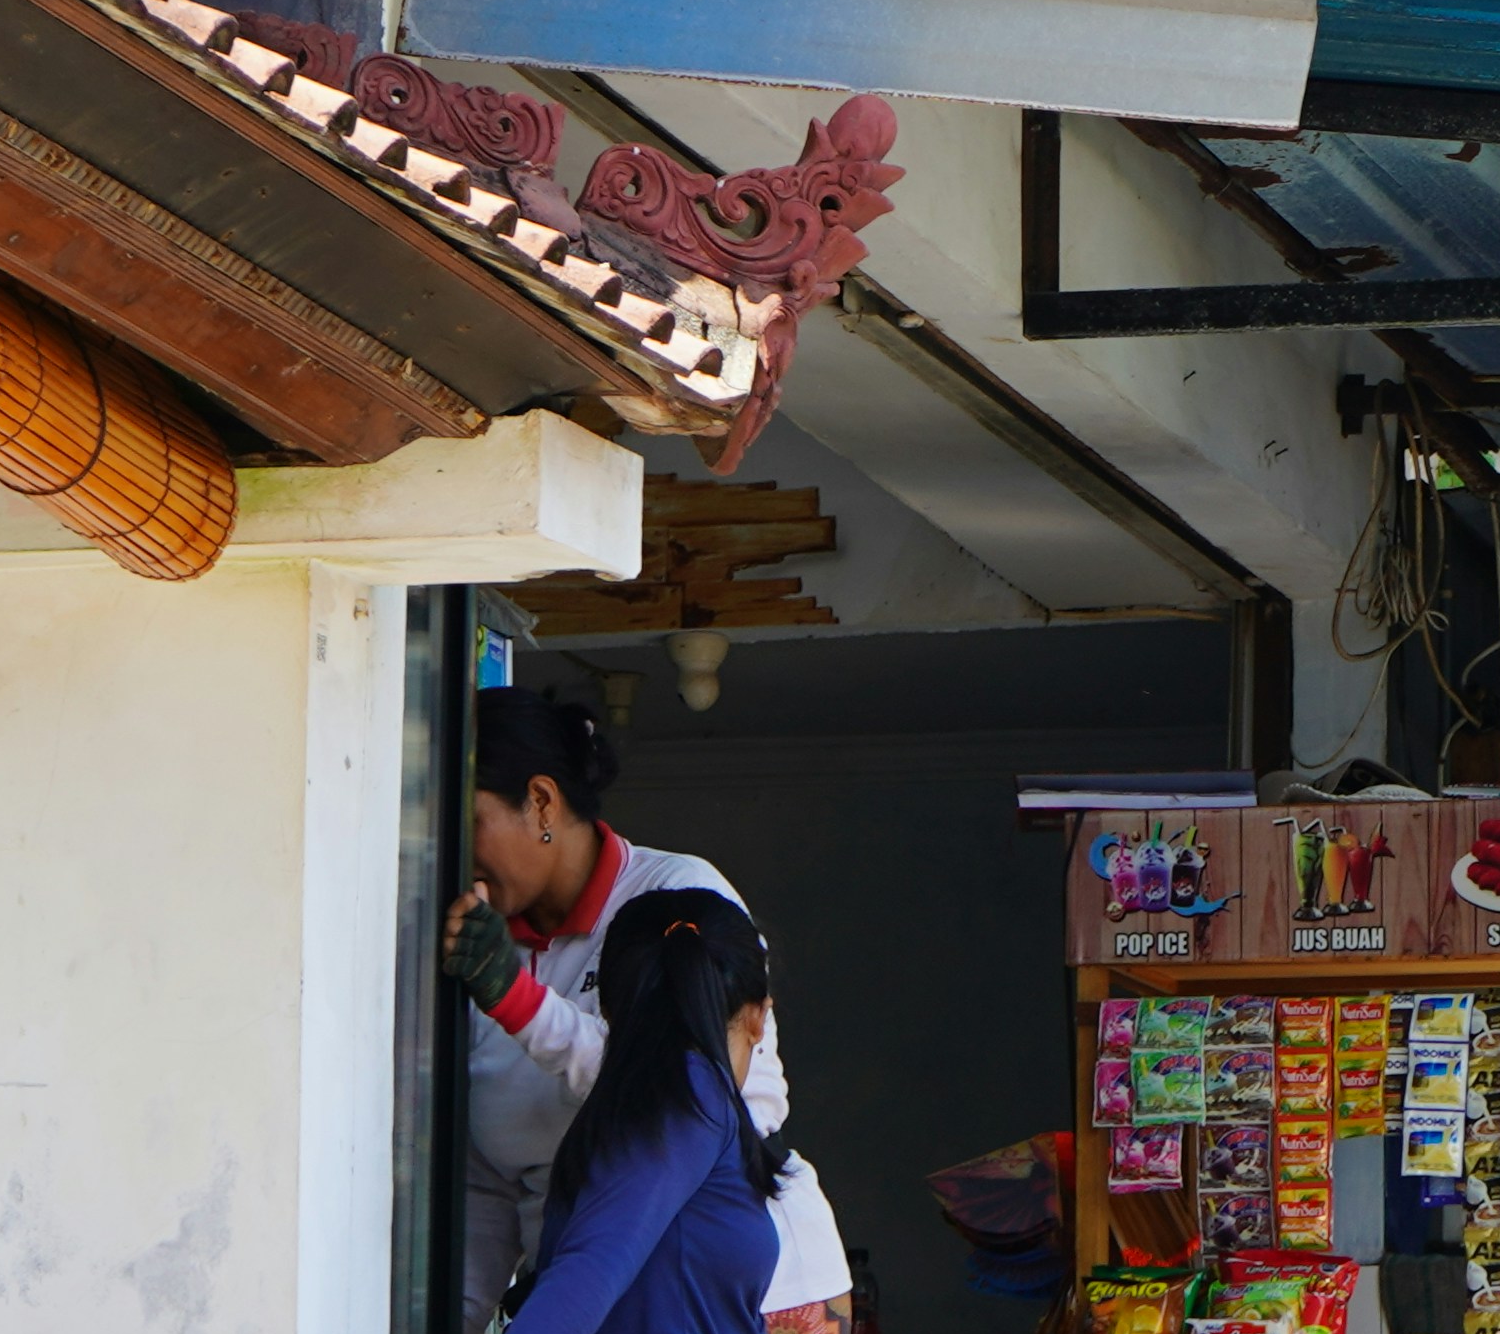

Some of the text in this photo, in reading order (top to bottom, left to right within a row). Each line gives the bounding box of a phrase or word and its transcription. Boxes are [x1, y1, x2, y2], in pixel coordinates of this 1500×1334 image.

[1115, 931, 1189, 957] POP ICE
[1293, 927, 1386, 952] JUS BUAH
[1413, 1049, 1462, 1059] INDOMILK
[1408, 1117, 1457, 1127] INDOMILK
